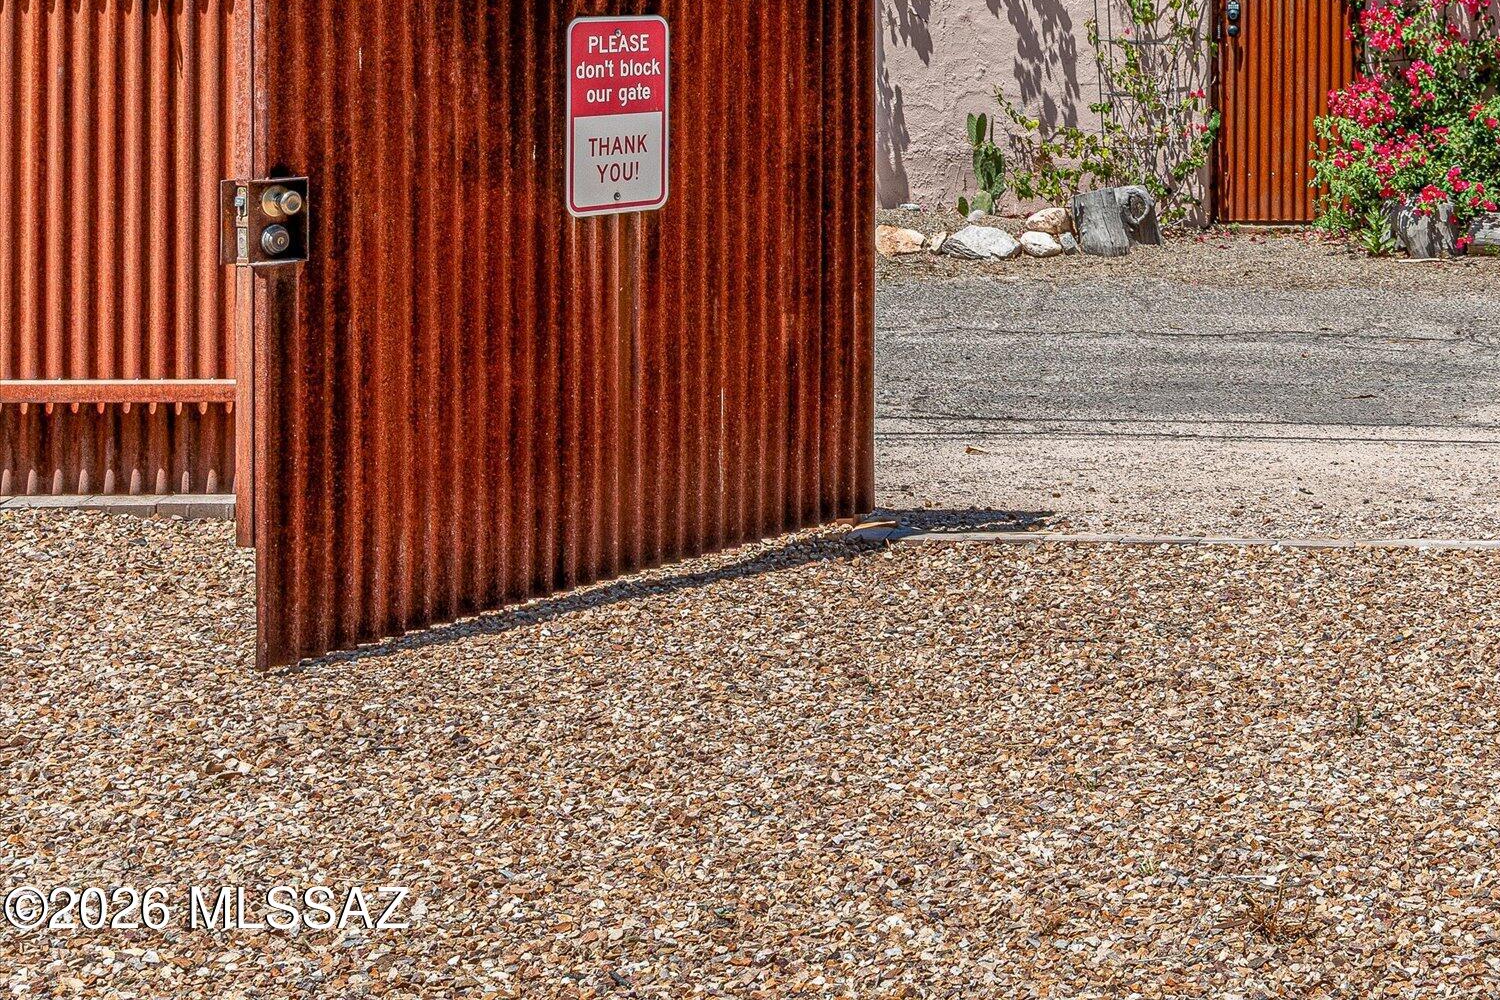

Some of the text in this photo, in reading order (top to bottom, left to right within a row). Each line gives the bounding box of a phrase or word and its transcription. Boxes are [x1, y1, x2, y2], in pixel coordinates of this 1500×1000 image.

[588, 34, 649, 53] PLEASE
[575, 58, 661, 79] don't block
[586, 83, 651, 107] our gate
[589, 135, 647, 156] THANK
[597, 162, 639, 183] YOU!
